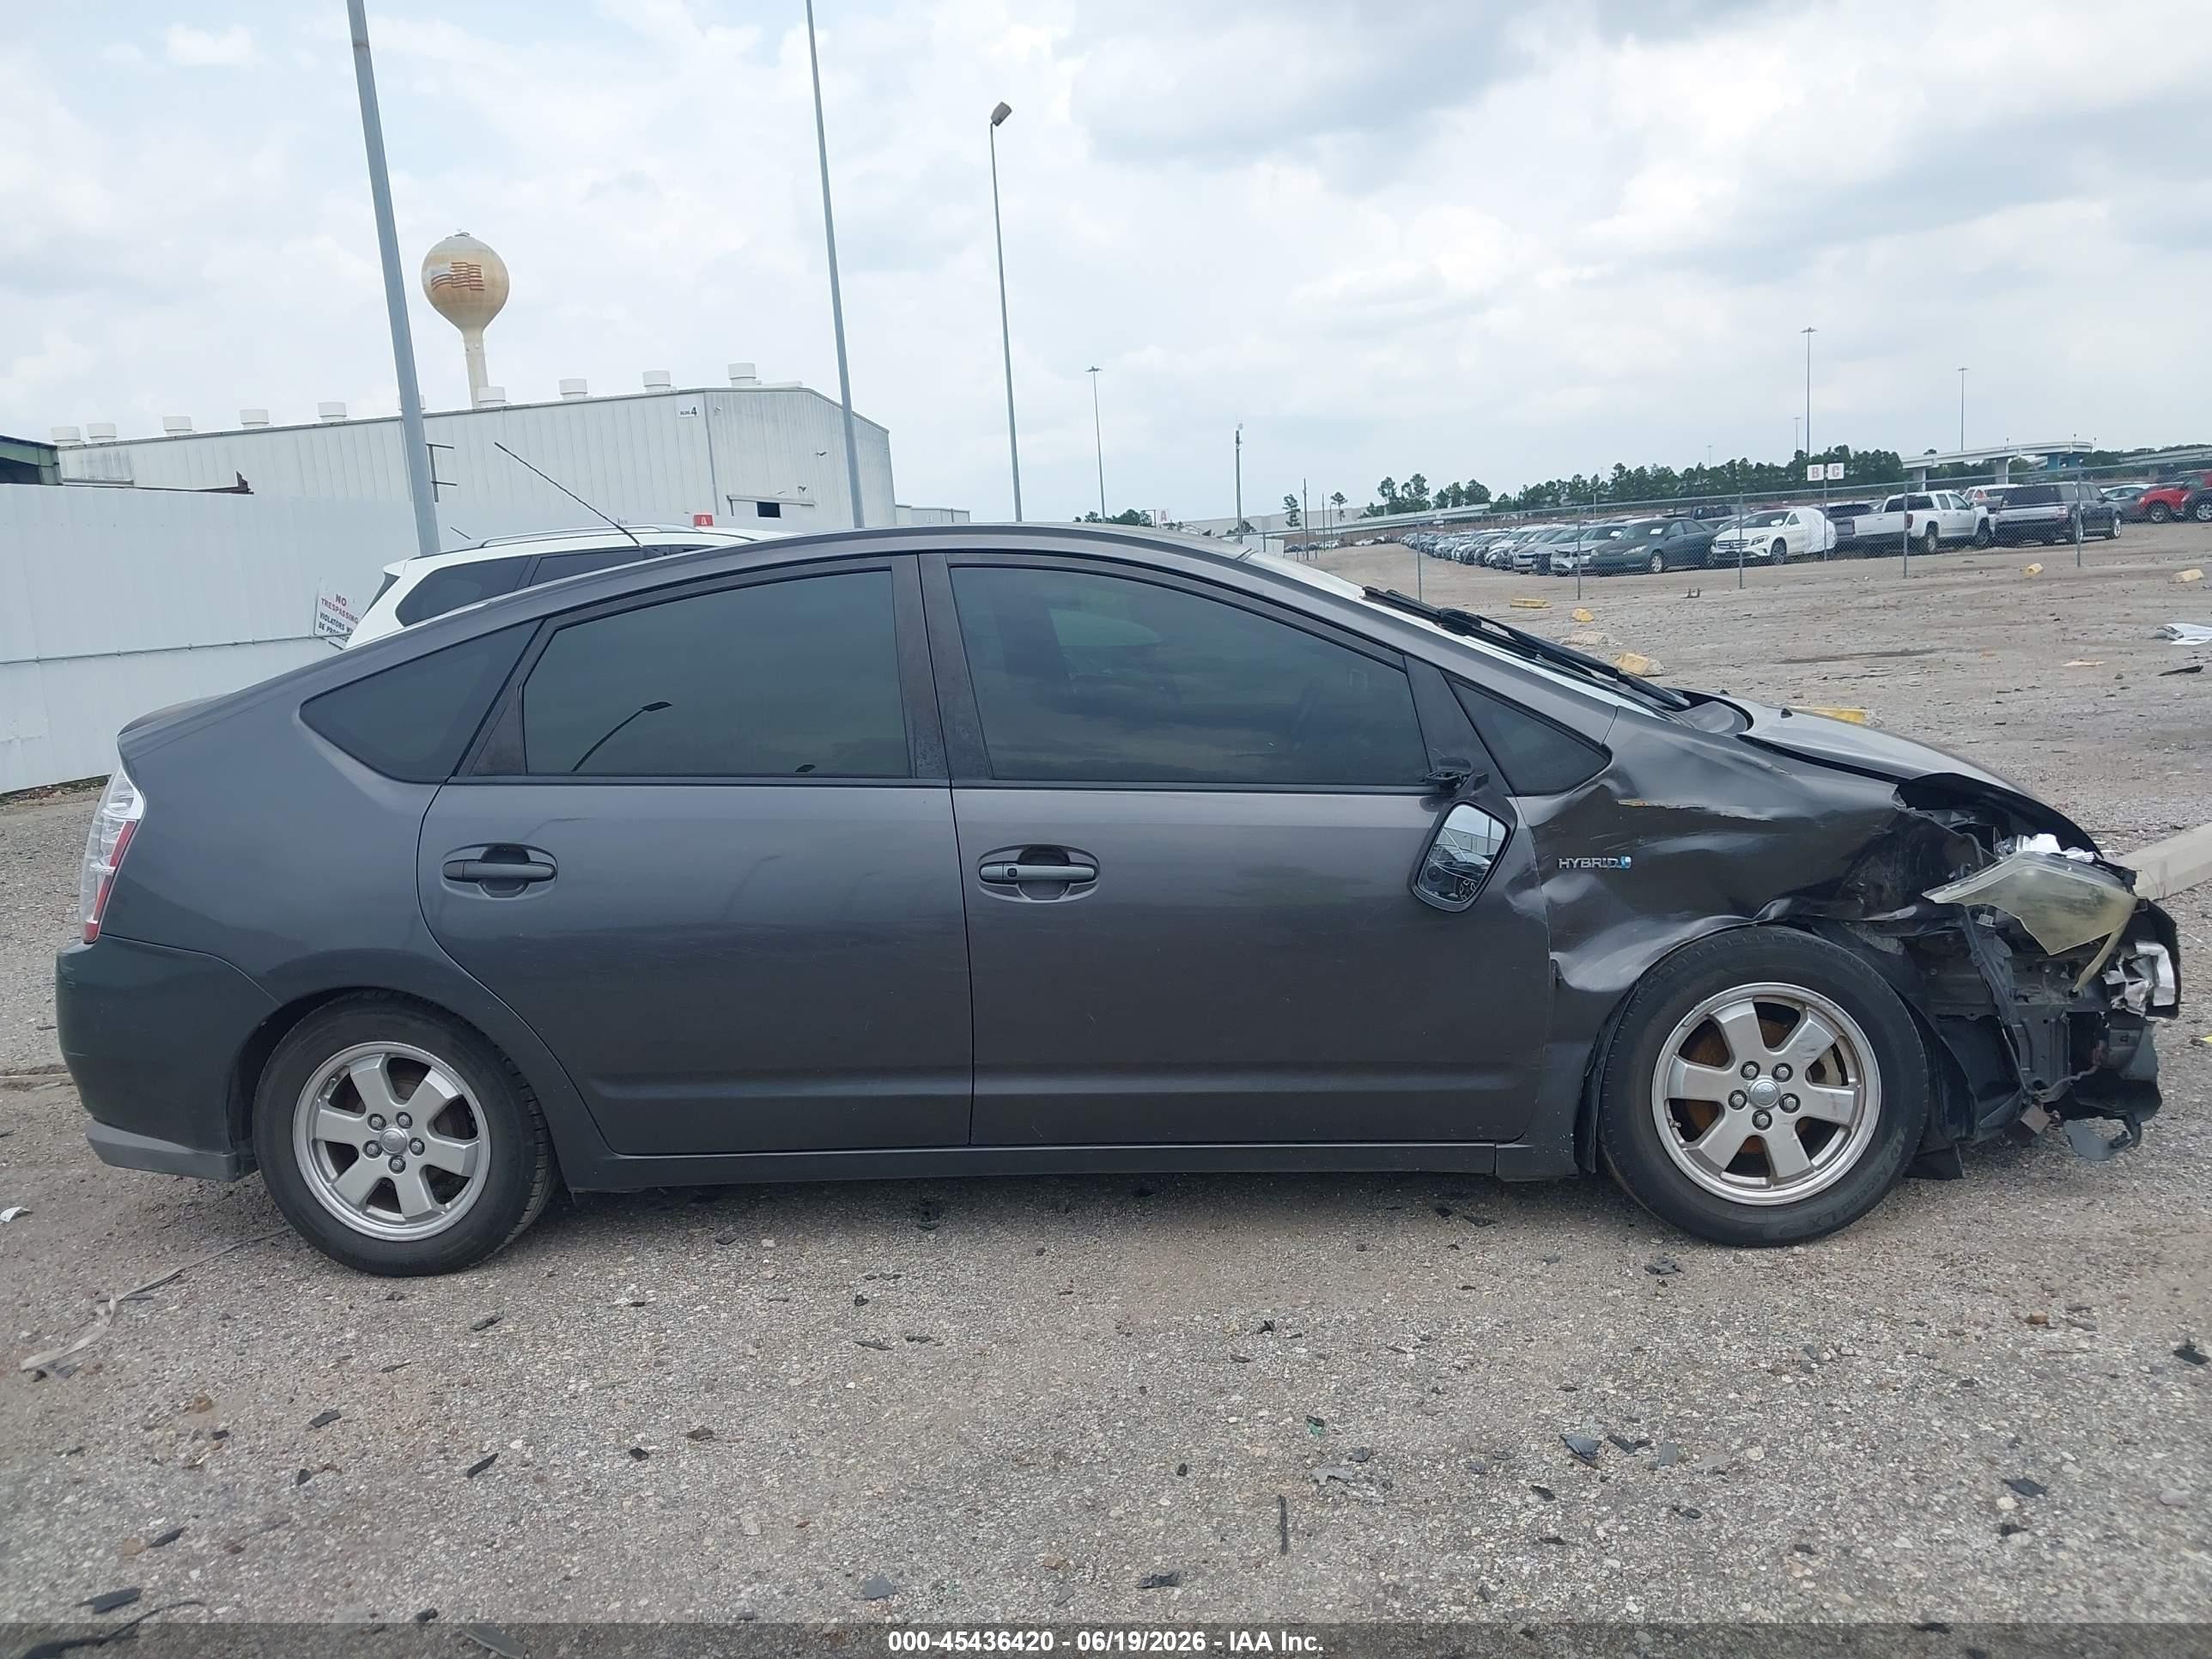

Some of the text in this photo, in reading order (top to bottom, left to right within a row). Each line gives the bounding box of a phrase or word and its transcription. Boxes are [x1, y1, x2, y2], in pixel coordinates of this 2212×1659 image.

[690, 406, 697, 416] 4
[336, 593, 347, 606] NO
[321, 598, 358, 624] TRESPASSING
[319, 611, 345, 630] VIOLATORS
[319, 621, 325, 630] BE
[1558, 857, 1620, 868] HYBRID
